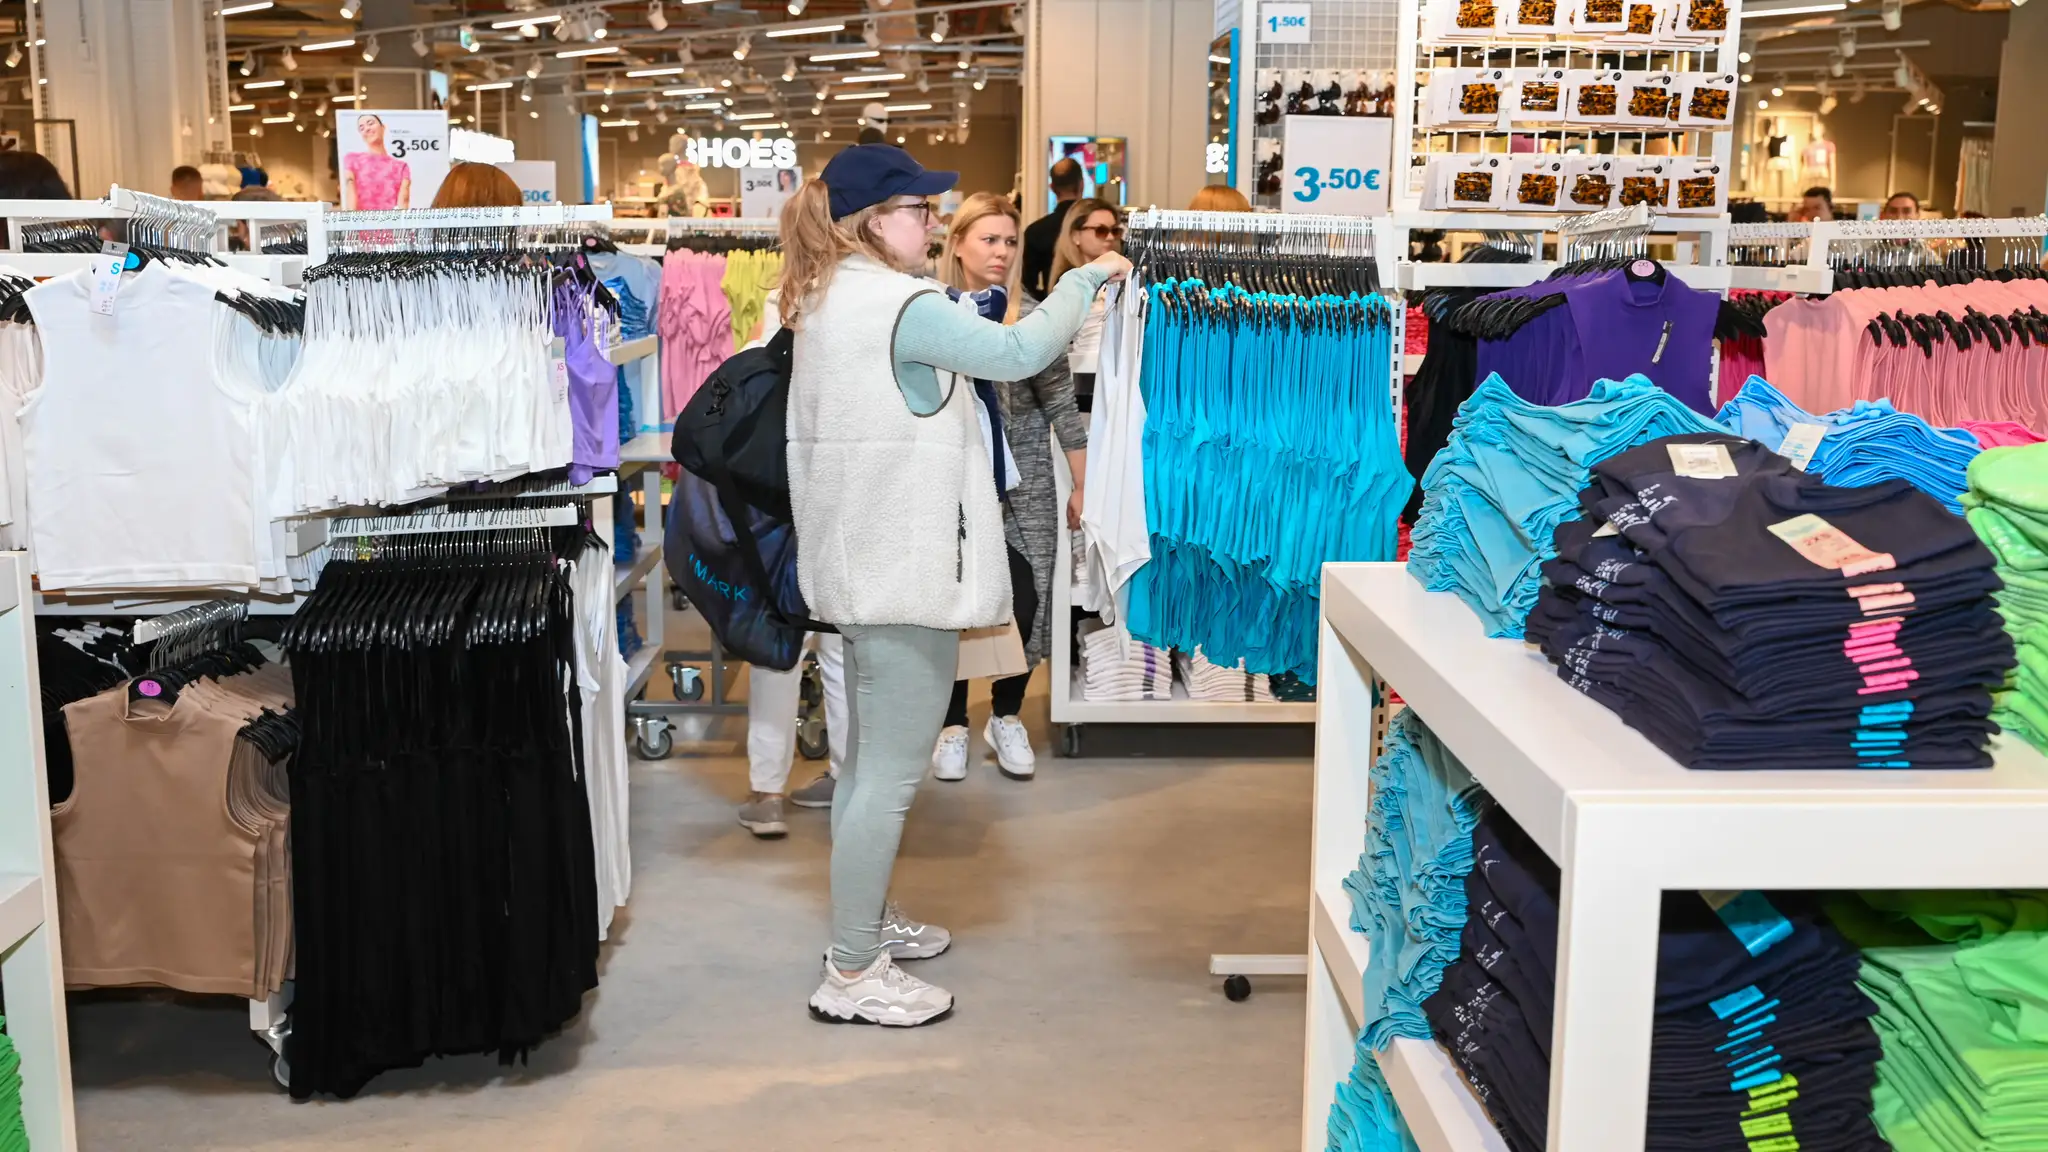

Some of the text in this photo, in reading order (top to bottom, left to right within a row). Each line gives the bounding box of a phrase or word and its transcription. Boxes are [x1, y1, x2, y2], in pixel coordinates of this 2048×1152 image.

[1268, 16, 1305, 33] 1.50€
[391, 139, 440, 158] 3.50€
[685, 137, 797, 169] SHOES
[1293, 166, 1380, 203] 3.50€
[110, 262, 121, 275] S
[556, 362, 565, 371] XS
